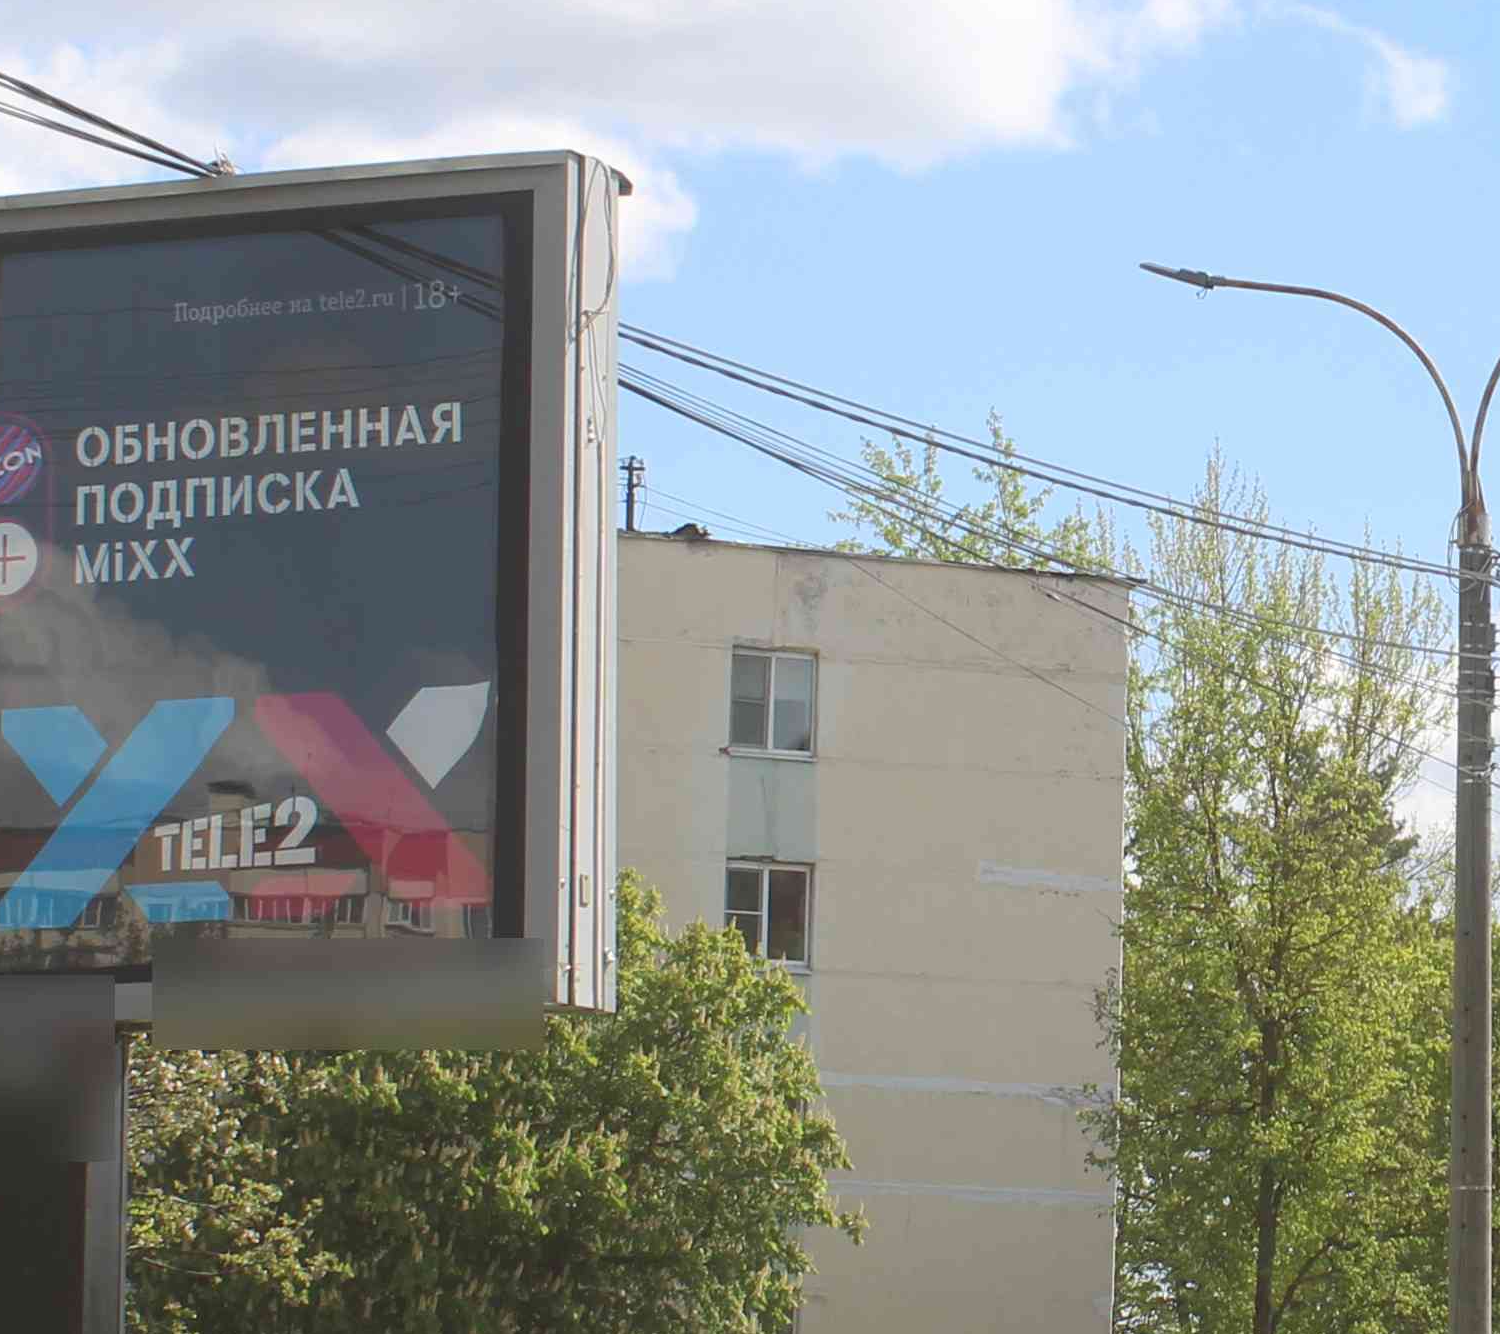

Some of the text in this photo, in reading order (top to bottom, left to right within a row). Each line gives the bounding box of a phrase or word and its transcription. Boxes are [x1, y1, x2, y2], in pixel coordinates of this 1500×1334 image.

[174, 279, 462, 325] Подробнее на tele2.ru 18+
[75, 401, 463, 468] ОБНОВЛЕННАЯ
[75, 467, 360, 531] ПОДПИСКА
[154, 795, 318, 872] TELE2
